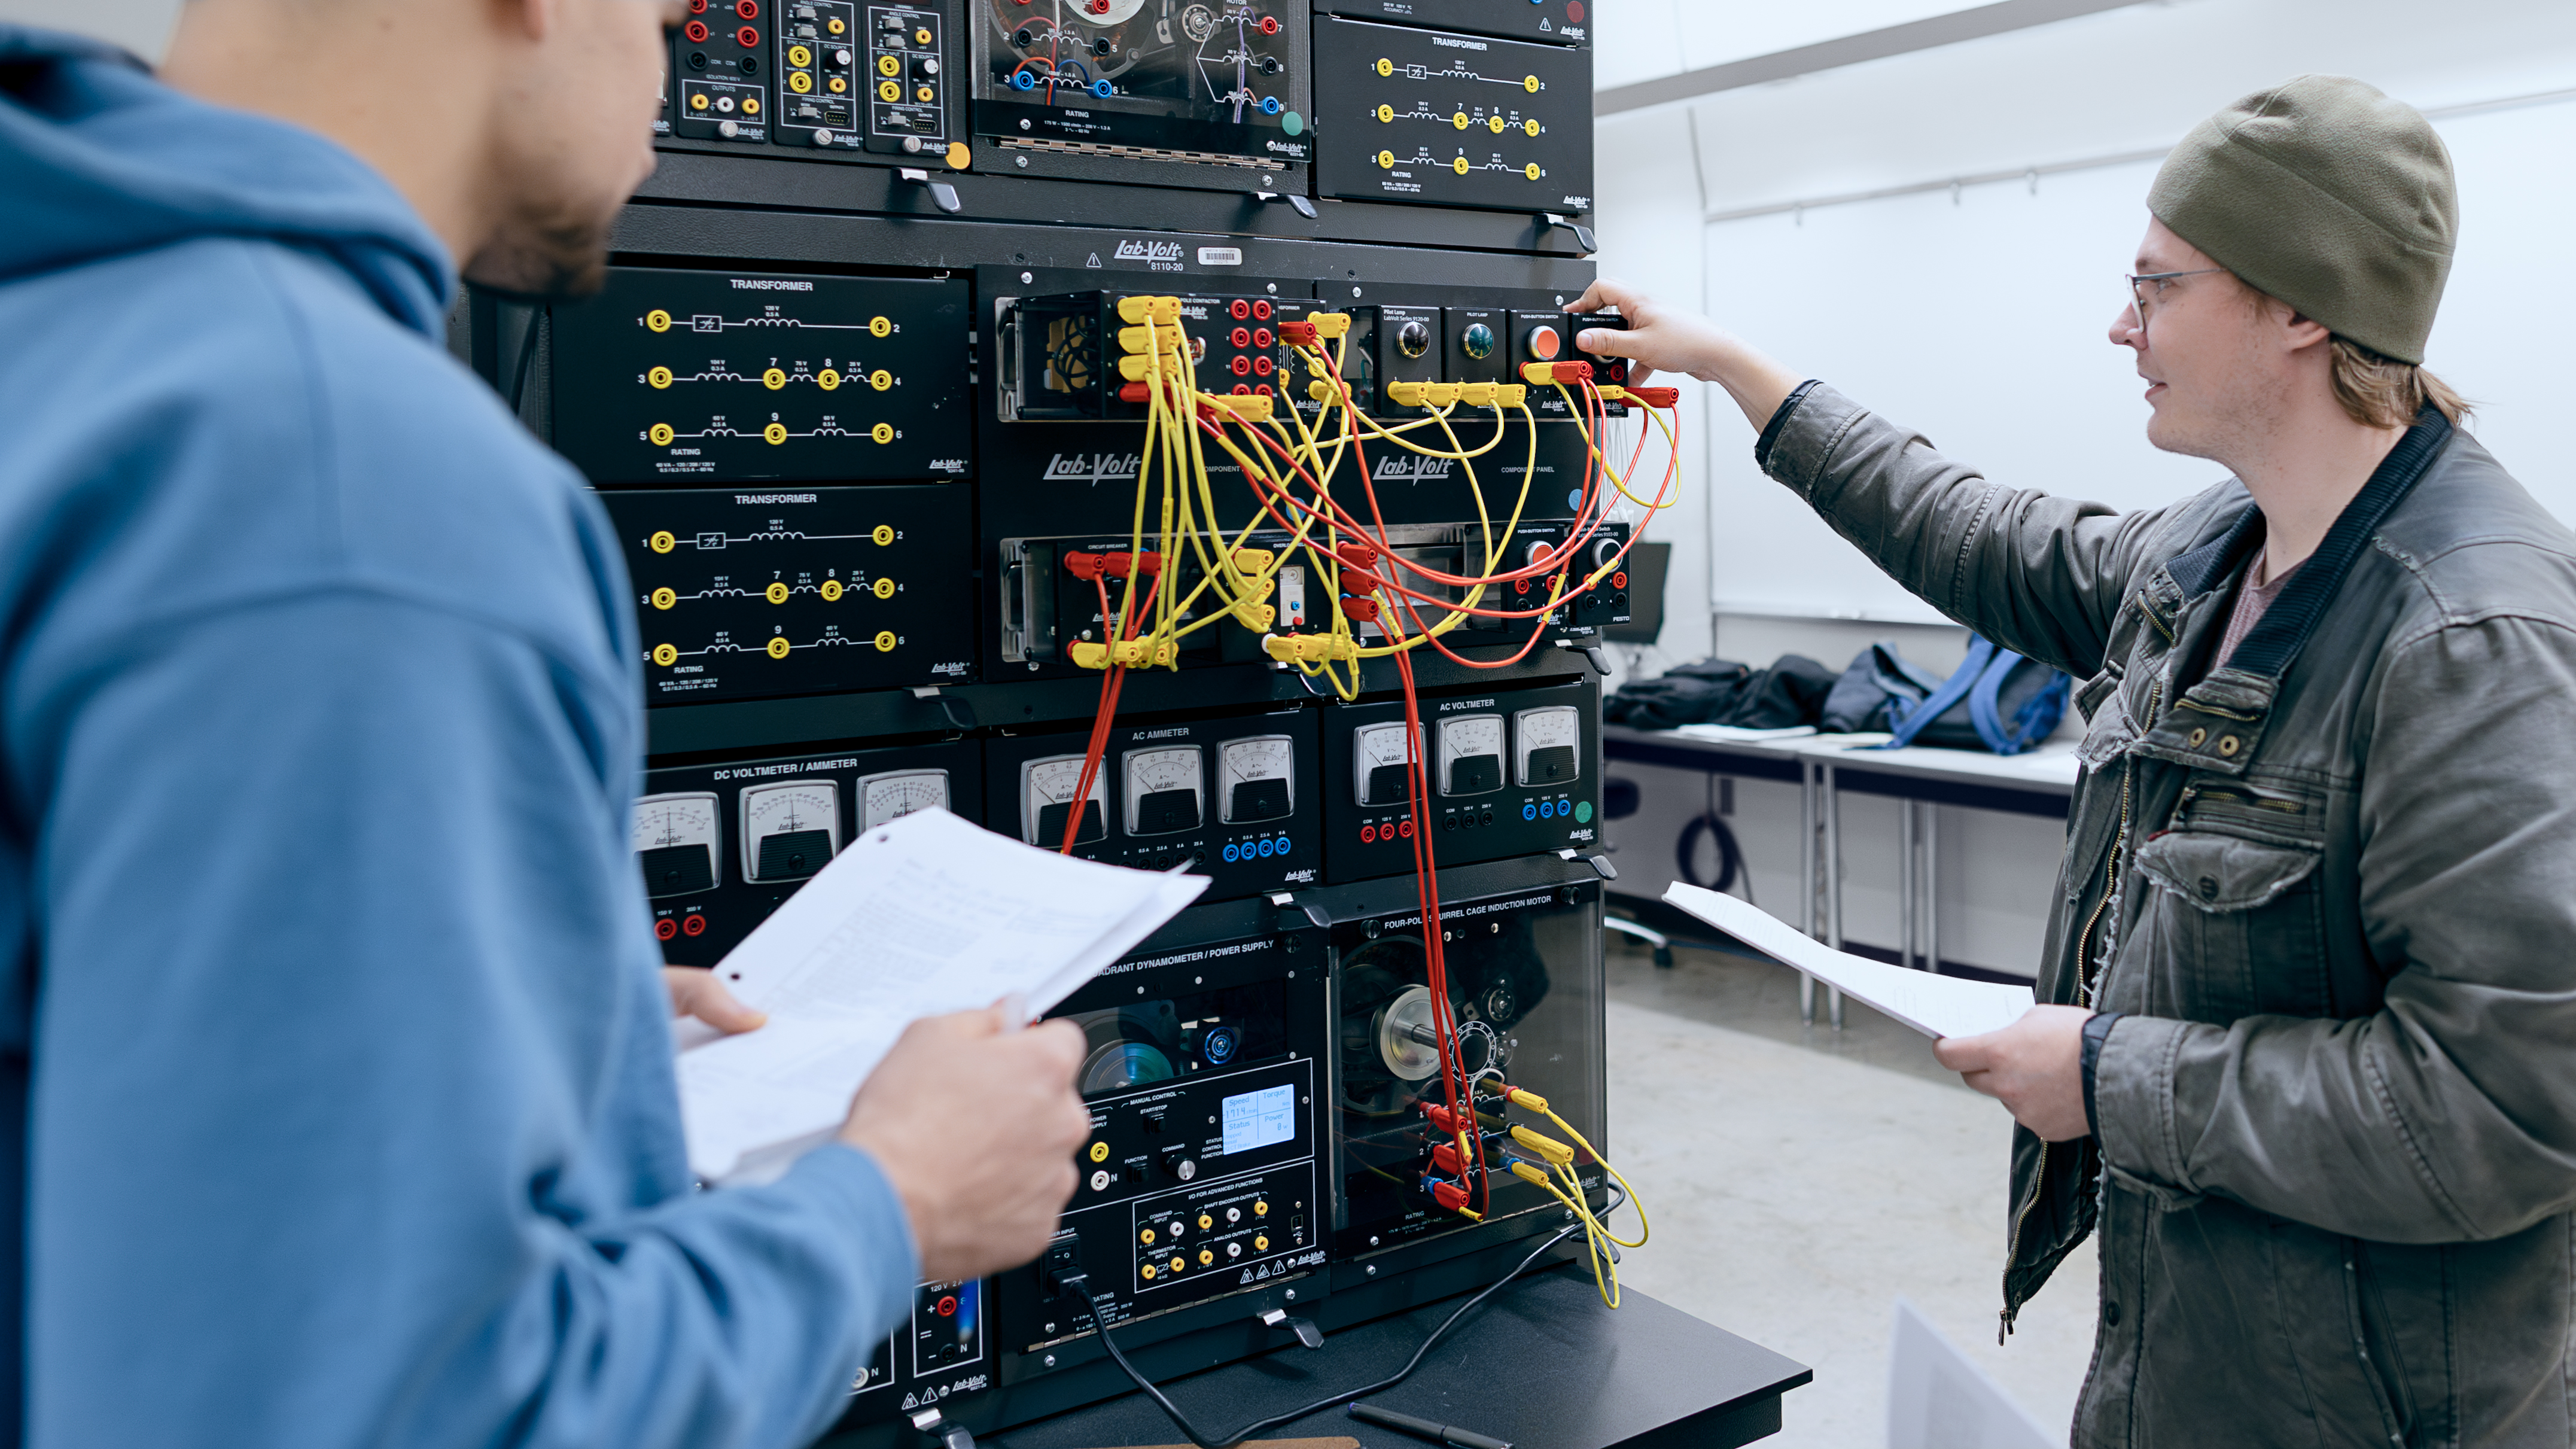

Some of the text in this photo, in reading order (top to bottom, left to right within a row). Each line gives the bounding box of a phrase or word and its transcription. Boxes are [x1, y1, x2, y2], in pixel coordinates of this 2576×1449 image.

[1004, 32, 1009, 40] 2
[1112, 44, 1117, 53] 5
[1432, 37, 1487, 51] TRANSFORMER
[1278, 64, 1284, 72] 8
[1004, 75, 1010, 83] 3
[1113, 86, 1118, 95] 6
[1275, 142, 1302, 153] Lab-Volt
[1563, 196, 1587, 206] Lab-Volt
[1113, 240, 1182, 264] Lab-Volt
[1151, 262, 1183, 271] 8110-20
[730, 279, 814, 292] TRANSFORMER
[638, 317, 644, 327] 1
[893, 324, 900, 333] 2
[770, 358, 777, 366] 7
[825, 358, 832, 368] 8
[638, 375, 646, 383] 3
[894, 377, 902, 386] 4
[1542, 400, 1564, 410] Lab-Volt
[772, 413, 779, 421] 9
[640, 431, 647, 441] 5
[896, 430, 903, 440] 6
[928, 459, 964, 471] Lab-Volt
[1043, 453, 1140, 486] Lab-Volt
[1372, 455, 1454, 487] Lab-Volt
[735, 494, 817, 505] TRANSFORMER
[897, 531, 903, 540] 2
[643, 538, 648, 547] 1
[774, 571, 781, 579] 7
[828, 568, 835, 577] 8
[897, 583, 904, 592] 4
[642, 595, 650, 604] 3
[774, 625, 781, 634] 9
[898, 637, 905, 645] 6
[643, 651, 650, 660] 5
[674, 665, 704, 674] RATING
[931, 662, 965, 674] Lab-Volt
[1452, 699, 1495, 710] VOLTMETER
[1132, 727, 1189, 740] AC AMMETER
[714, 758, 857, 780] DC VOLTMETER AMMETER
[1569, 829, 1592, 840] Lab-Volt
[1284, 869, 1313, 882] Lab-Volt
[1384, 896, 1552, 929] FOUR-POL SUIRREL CAGE INDUCTION MOTOR
[1092, 940, 1274, 978] UADRANT DYNAMOMETER POWER SUPPLY
[1129, 1092, 1177, 1105] MANUAL CONTROL
[1263, 1089, 1286, 1100] Torque
[1229, 1097, 1249, 1108] Speed
[1140, 1105, 1168, 1114] START/STOP
[1229, 1121, 1250, 1130] Status
[1162, 1144, 1185, 1153] COMMAND
[1125, 1155, 1147, 1164] FUNCTION
[1201, 1150, 1223, 1159] FUNCTION
[1208, 1185, 1234, 1195] ADVANCED
[1235, 1178, 1263, 1189] FUNCTIONS
[1204, 1192, 1259, 1209] SHAFT ENCODER OUTPUTS
[1149, 1210, 1173, 1220] COMMAND
[1405, 1210, 1424, 1220] RATING
[1214, 1228, 1252, 1242] ANALOG OUTPUTS
[1147, 1245, 1176, 1256] THERMISTOR
[1297, 1250, 1323, 1265] Lab-Volt
[960, 1344, 967, 1353] N
[871, 1368, 879, 1377] N
[952, 1374, 985, 1392] Lab-Volt
